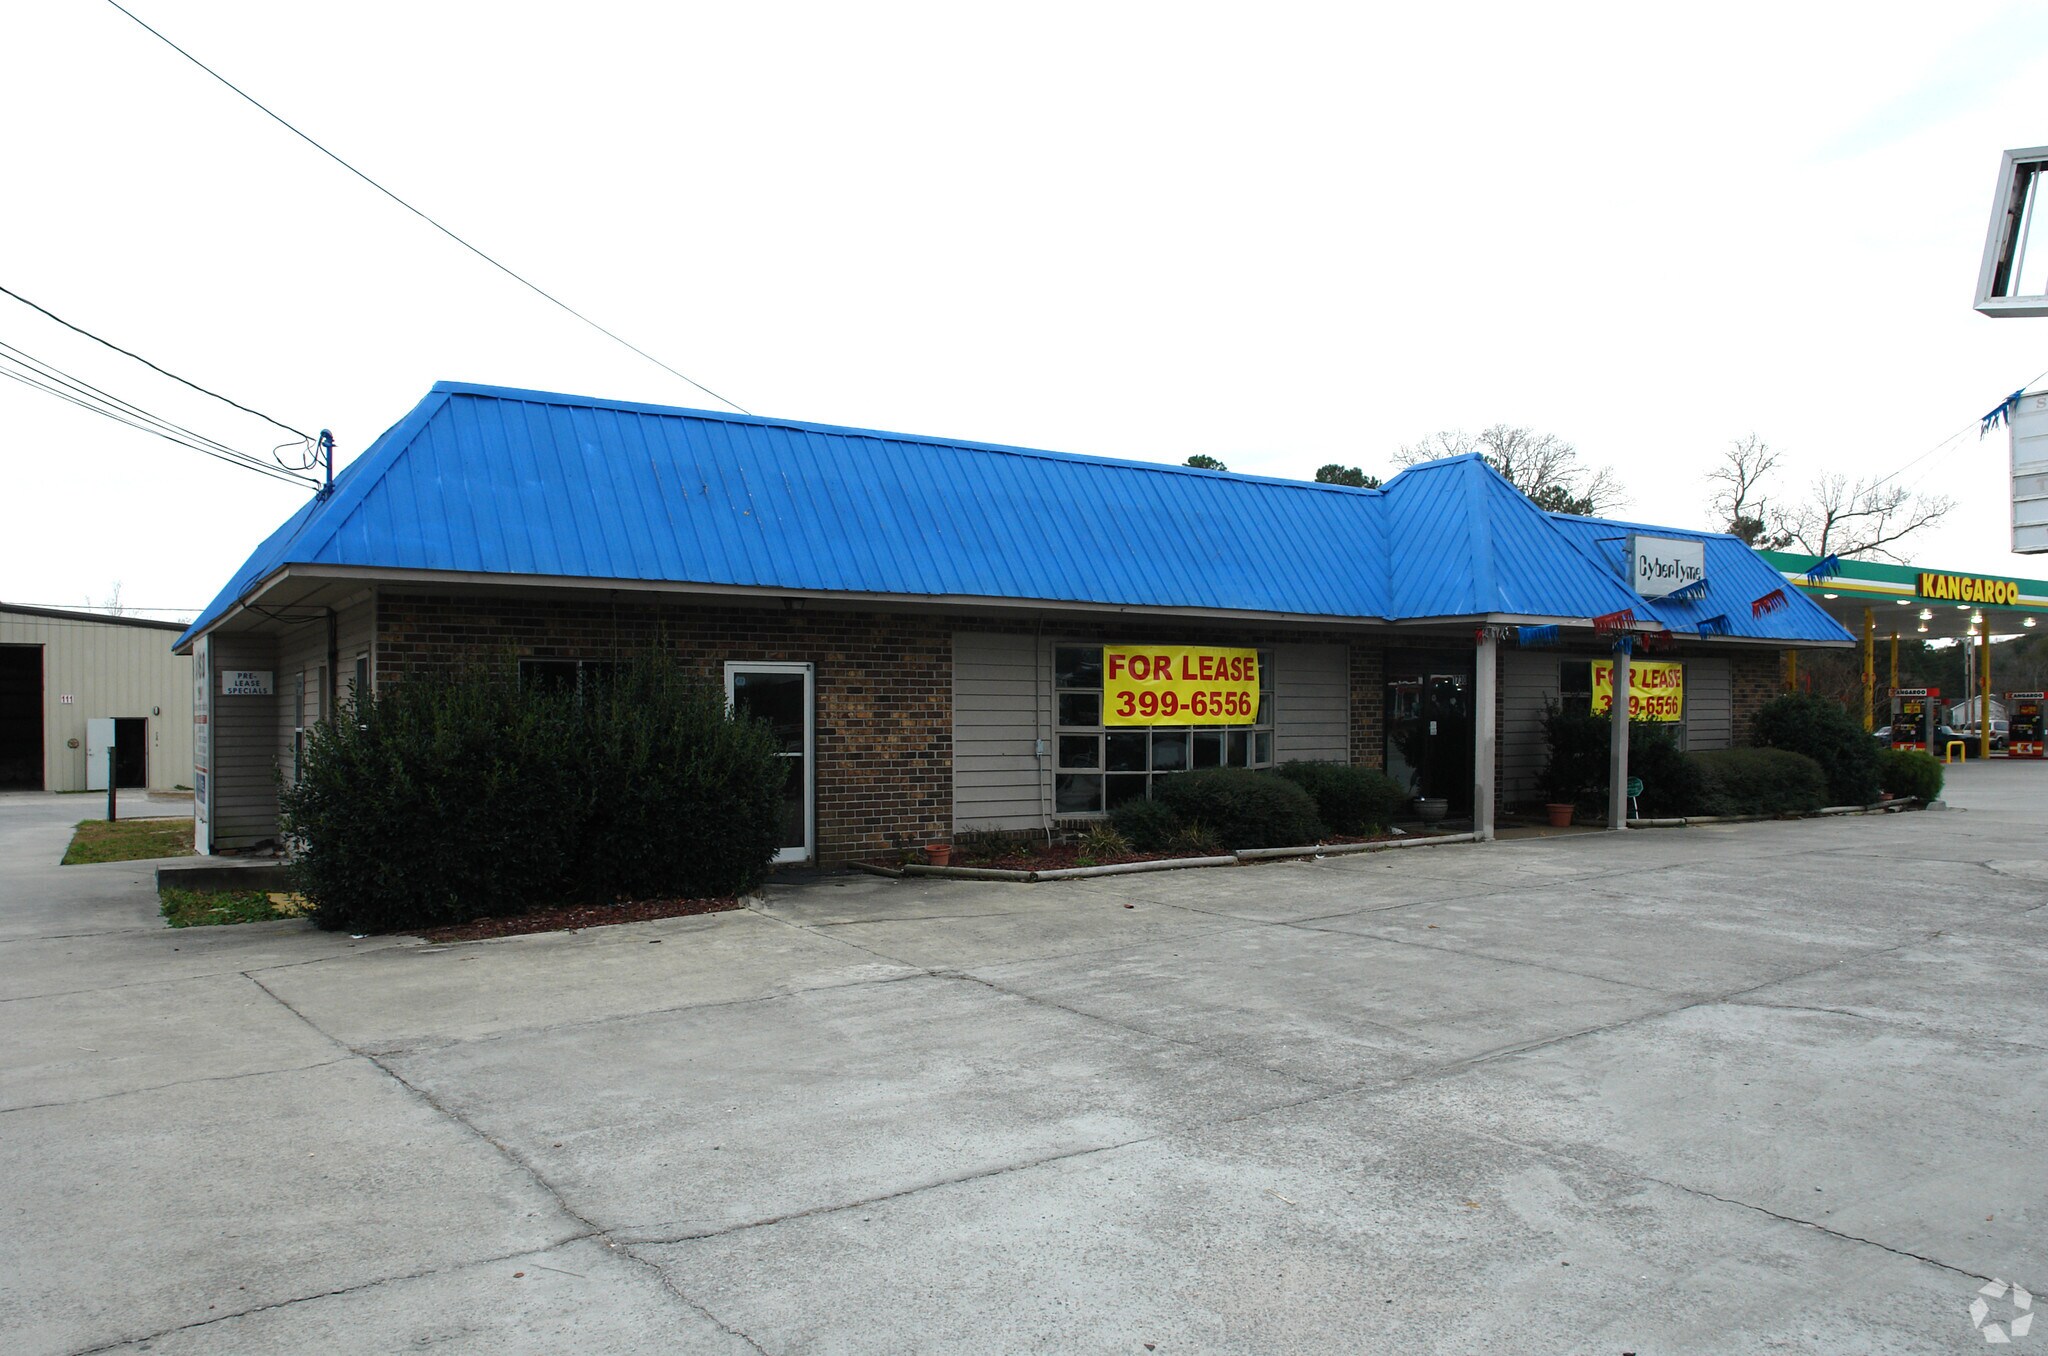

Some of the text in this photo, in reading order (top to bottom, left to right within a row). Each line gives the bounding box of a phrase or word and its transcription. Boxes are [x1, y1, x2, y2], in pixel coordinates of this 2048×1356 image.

[1639, 554, 1702, 583] CyberTyme
[1921, 572, 2019, 606] KANGAROO
[1108, 654, 1255, 681] FOR LEASE
[1595, 666, 1681, 688] FR LEASE
[61, 695, 73, 704] 111
[1116, 690, 1252, 717] 399-6556
[1600, 694, 1678, 715] 39-6556
